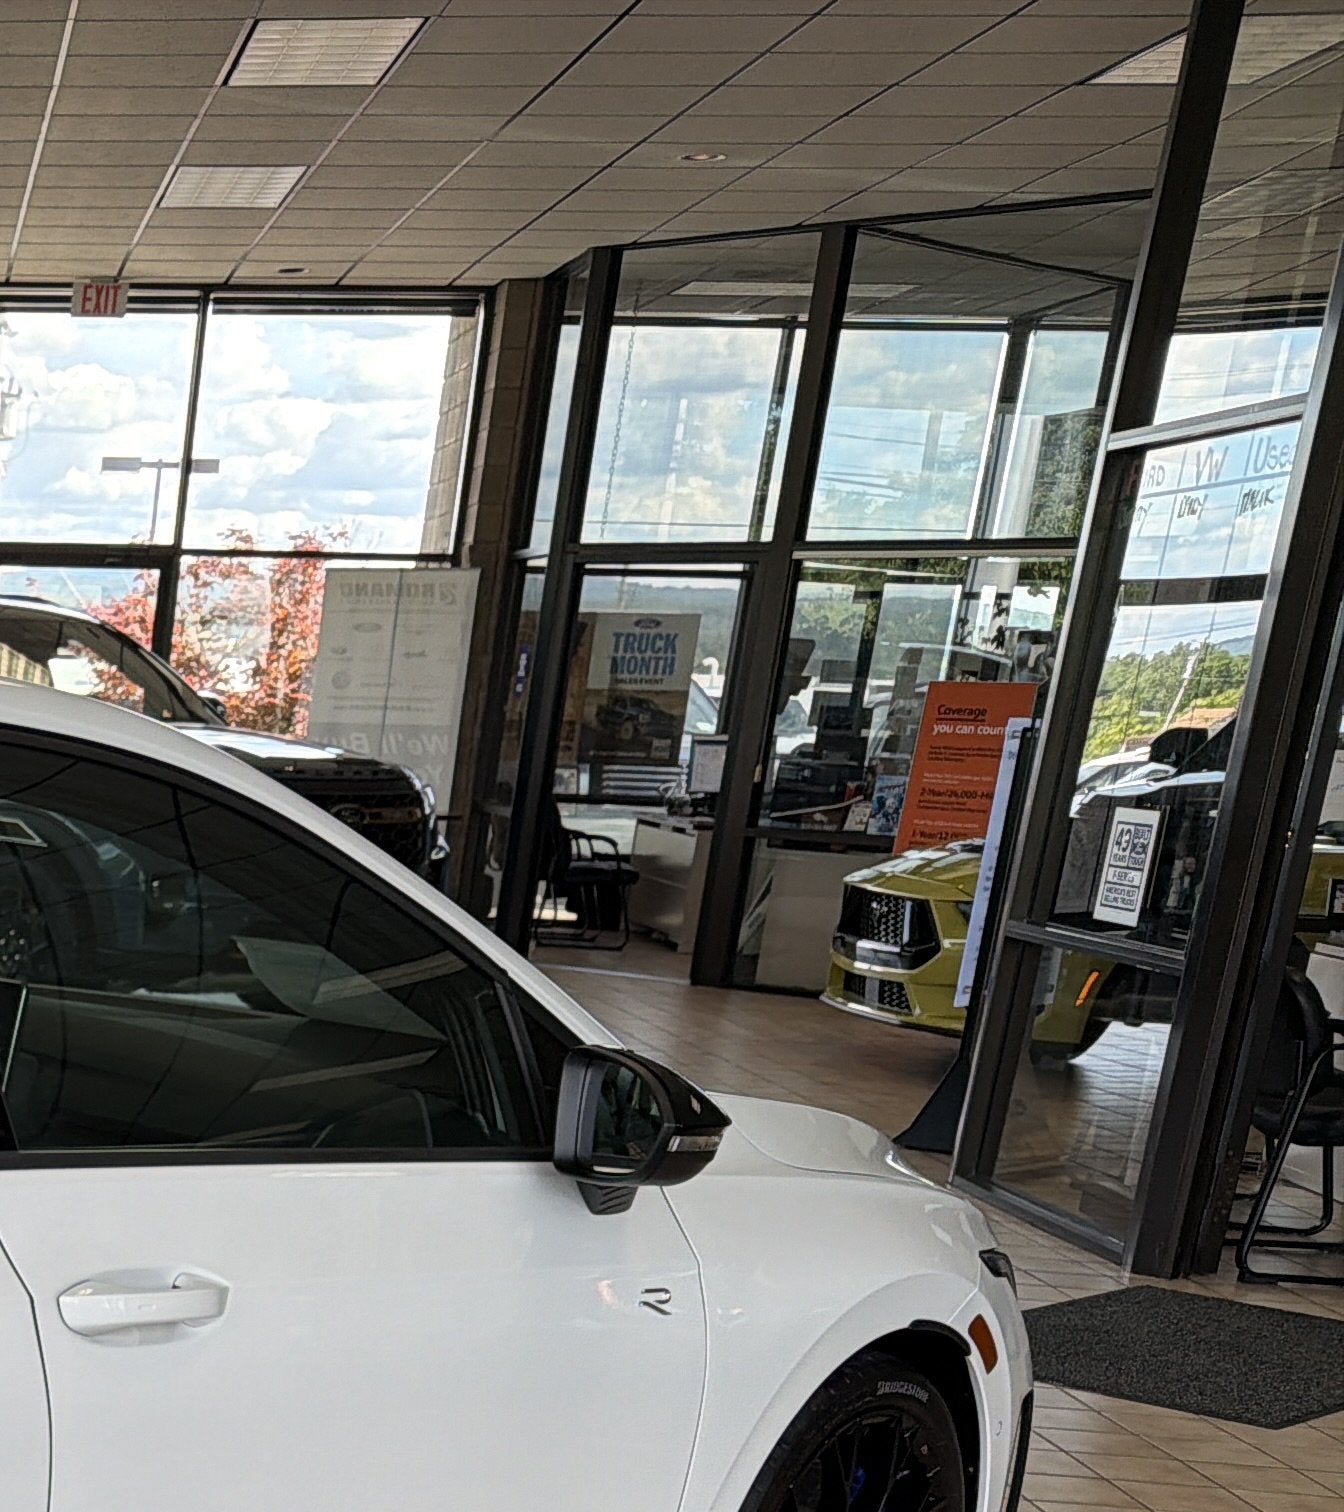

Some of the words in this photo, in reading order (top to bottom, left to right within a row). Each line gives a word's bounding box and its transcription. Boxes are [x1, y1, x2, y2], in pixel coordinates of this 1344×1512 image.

[81, 284, 122, 314] EXIT
[612, 632, 679, 654] TRUCK
[609, 656, 677, 676] MONTH
[937, 704, 988, 717] Coverage
[932, 724, 954, 736] you
[955, 724, 975, 735] can
[1115, 827, 1132, 853] 43
[876, 1380, 929, 1403] BRIDGESTONE
